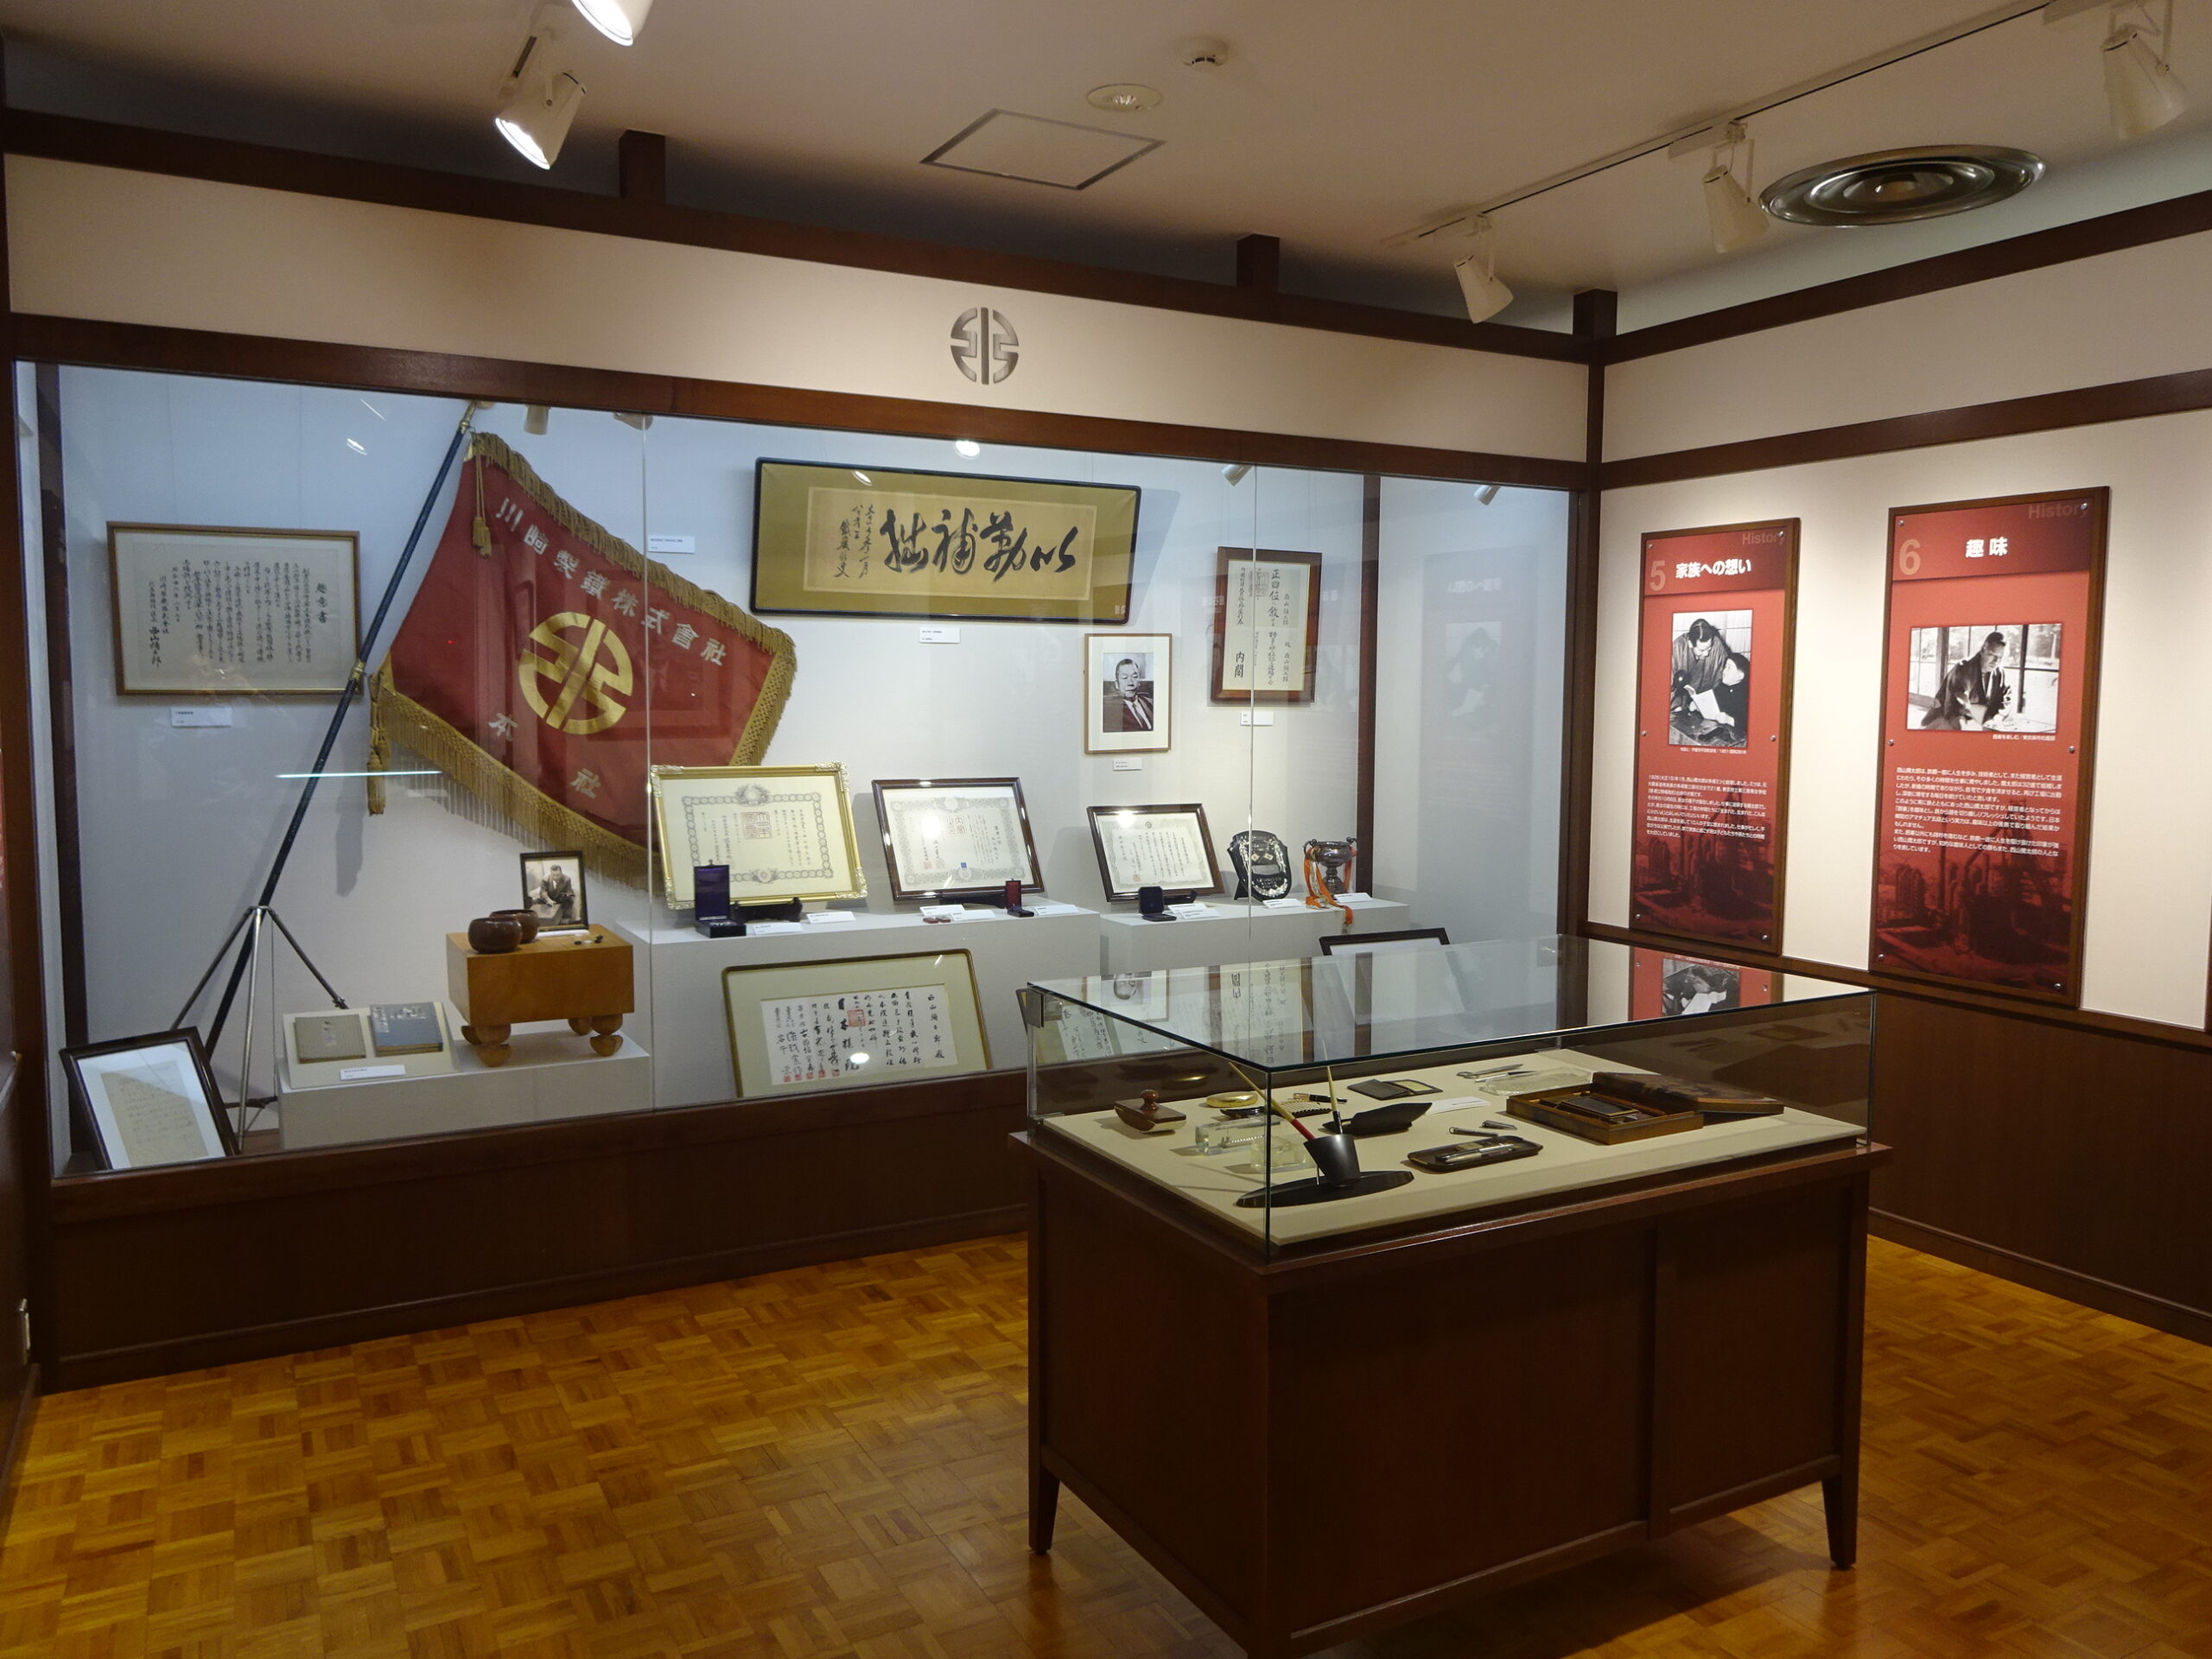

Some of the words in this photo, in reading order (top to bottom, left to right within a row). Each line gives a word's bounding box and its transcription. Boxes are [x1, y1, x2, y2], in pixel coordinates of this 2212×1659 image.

[1899, 539, 1921, 575] 6
[1965, 537, 2008, 558] 趣味
[1649, 560, 1666, 591] 5
[1675, 559, 1751, 579] 家族への想い
